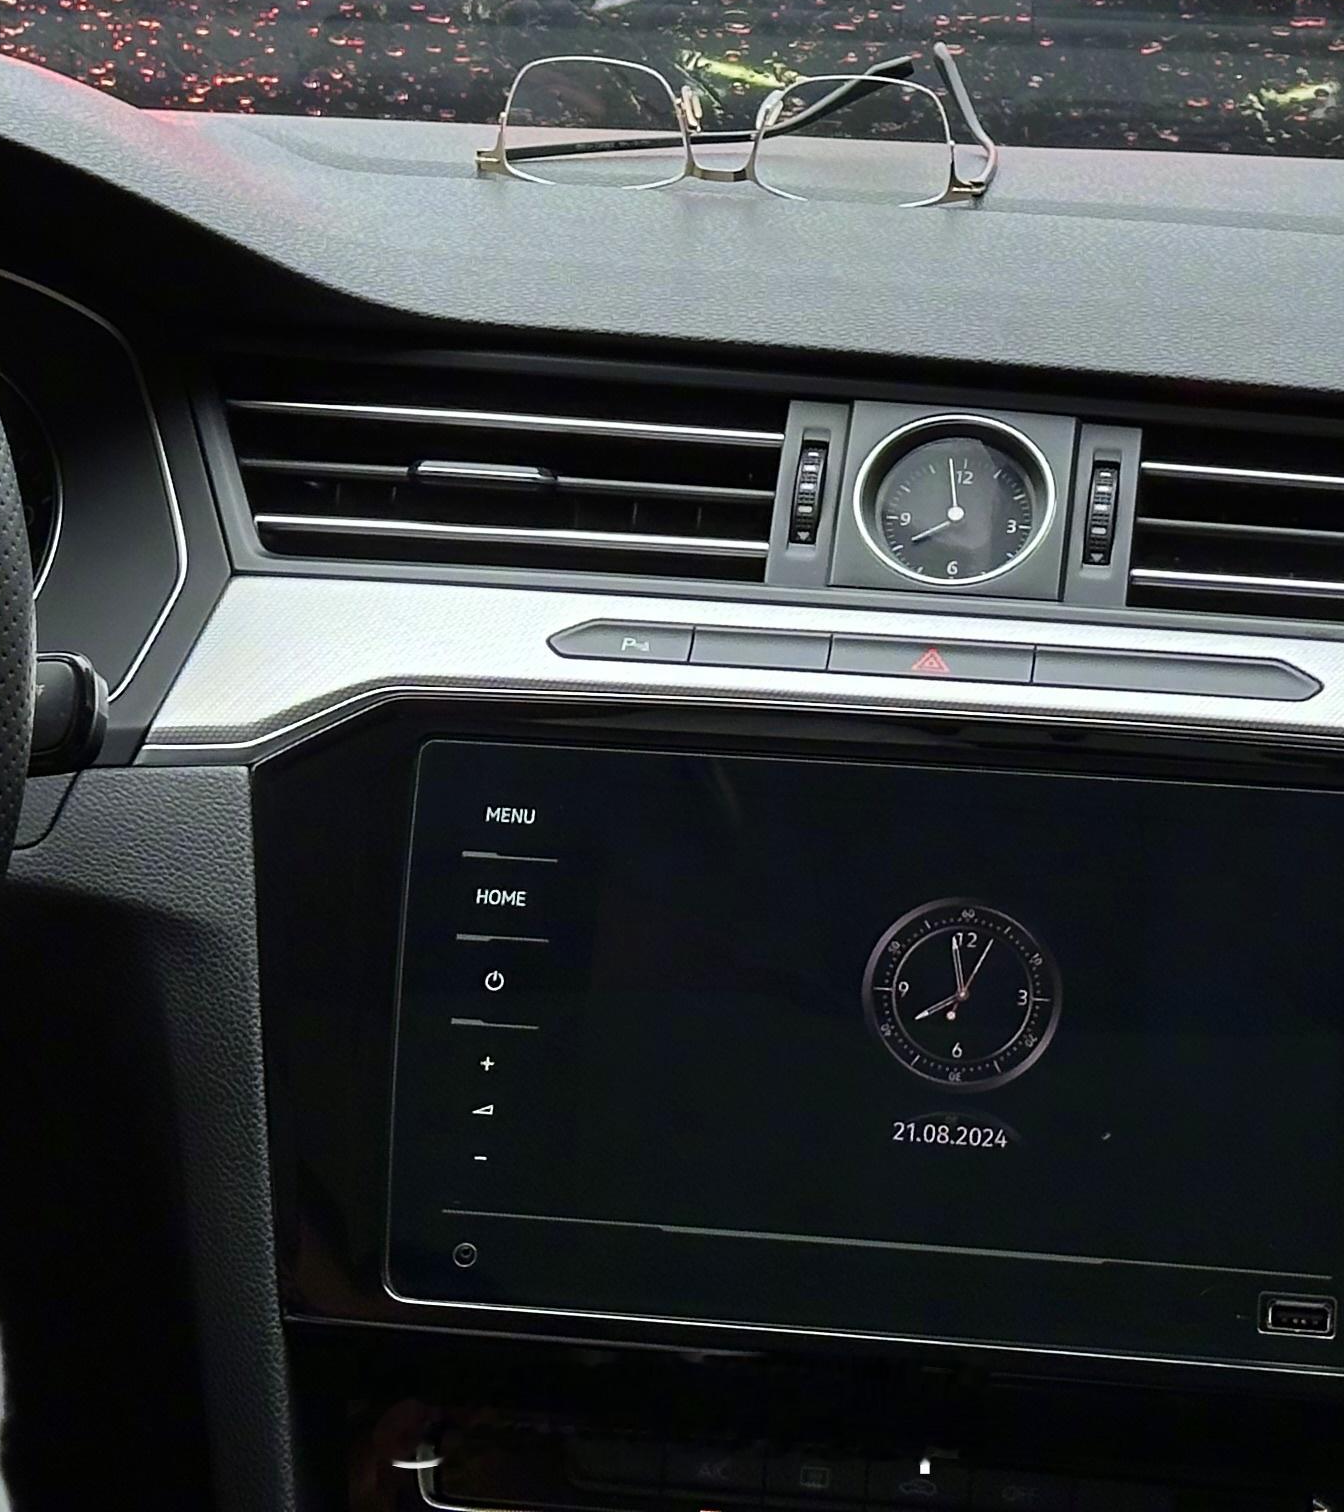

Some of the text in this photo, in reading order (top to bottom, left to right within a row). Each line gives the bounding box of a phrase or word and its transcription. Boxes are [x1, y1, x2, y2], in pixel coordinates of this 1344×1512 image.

[957, 469, 975, 486] 12
[900, 511, 912, 526] 9
[1006, 519, 1018, 534] 3
[946, 560, 959, 577] 6
[485, 805, 536, 825] MENU
[476, 888, 528, 907] HOME
[955, 931, 979, 949] 12
[897, 980, 911, 999] 9
[1016, 988, 1029, 1007] 3
[951, 1040, 964, 1060] 6
[891, 1120, 1009, 1150] 21.08.2024
